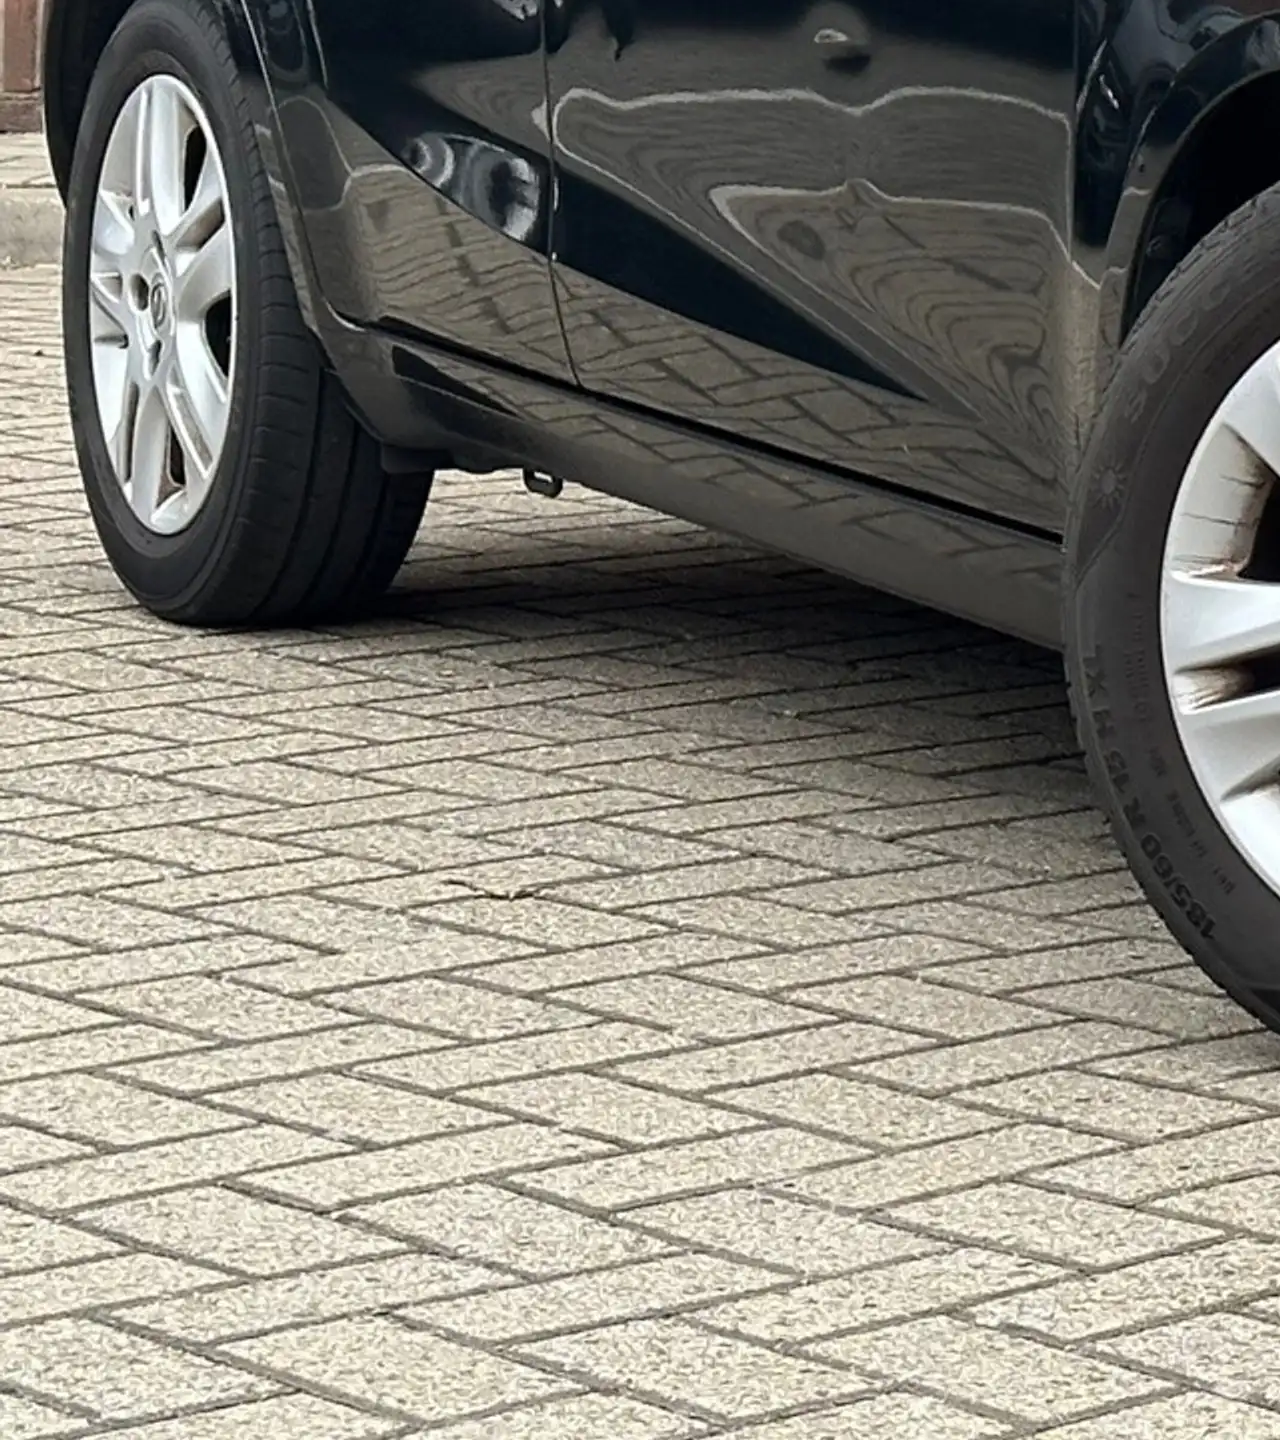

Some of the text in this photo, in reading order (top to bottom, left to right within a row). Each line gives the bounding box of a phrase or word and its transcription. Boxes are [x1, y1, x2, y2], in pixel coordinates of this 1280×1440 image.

[1104, 749, 1131, 794] 15
[1123, 797, 1146, 828] R
[1140, 832, 1216, 942] 185/60
